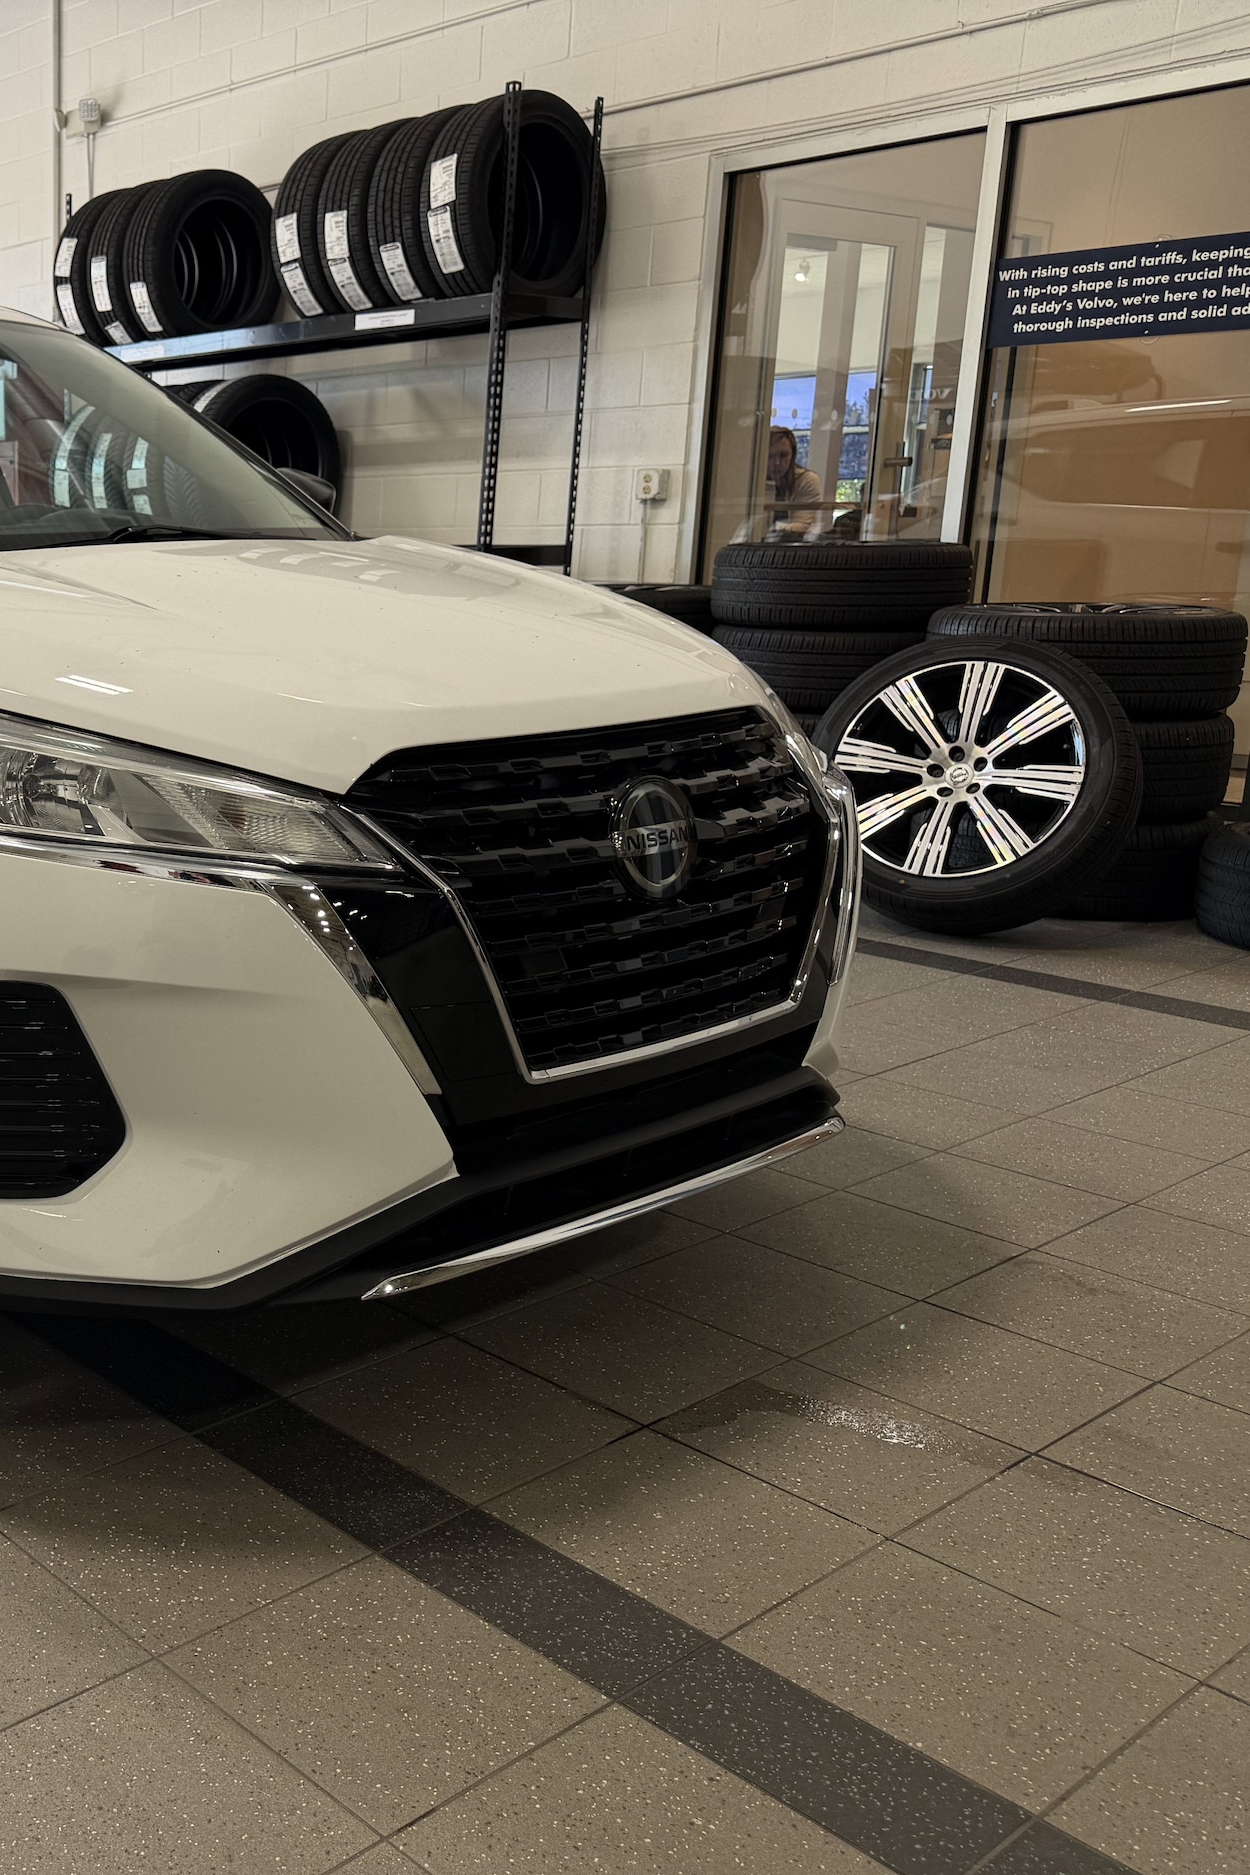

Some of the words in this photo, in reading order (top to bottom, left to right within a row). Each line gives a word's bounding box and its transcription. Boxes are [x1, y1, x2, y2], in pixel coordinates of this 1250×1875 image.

[999, 268, 1028, 281] With
[1031, 265, 1069, 278] rising
[1072, 261, 1105, 274] costs
[1109, 256, 1137, 270] and
[1141, 251, 1187, 267] tariffs,
[1191, 245, 1250, 262] keeping
[1007, 287, 1020, 299] in
[1023, 284, 1068, 299] tip-top
[1071, 280, 1113, 293] shape
[1117, 276, 1129, 288] is
[1132, 274, 1170, 287] more
[1174, 265, 1223, 283] crucial
[1012, 304, 1027, 316] At
[1030, 300, 1073, 315] Eddy’s
[1076, 296, 1118, 310] Volvo,
[1122, 293, 1160, 306] we're
[1163, 290, 1198, 303] here
[1202, 288, 1217, 299] to
[1013, 317, 1073, 333] thorough
[1076, 312, 1154, 330] inspections
[1158, 307, 1187, 322] and
[1190, 303, 1227, 319] solid
[626, 825, 689, 851] NISSAN
